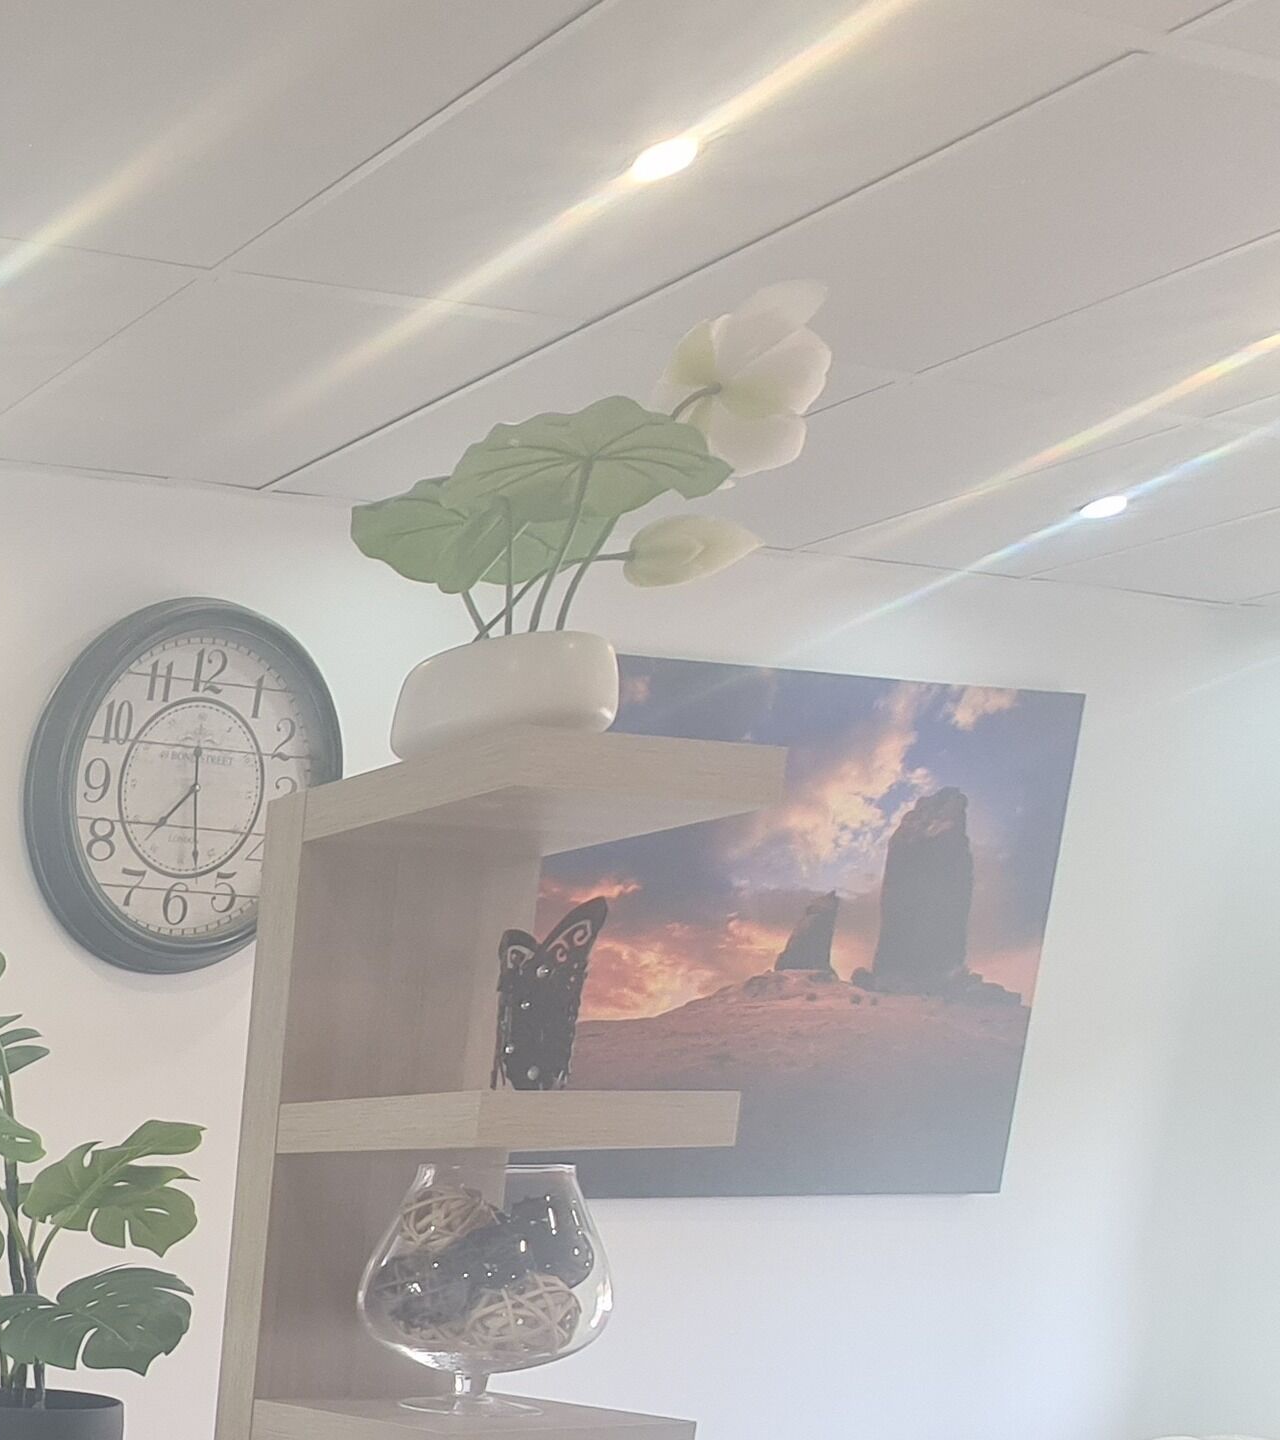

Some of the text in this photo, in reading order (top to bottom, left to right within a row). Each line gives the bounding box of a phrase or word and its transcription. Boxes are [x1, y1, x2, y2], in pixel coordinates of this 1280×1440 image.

[147, 659, 175, 702] 11
[191, 648, 228, 693] 12
[251, 675, 265, 718] 1
[102, 699, 133, 745] 10
[271, 718, 296, 761] 2
[83, 758, 111, 802] 9
[86, 818, 116, 861] 8
[121, 868, 146, 906] 7
[162, 882, 188, 925] 6
[210, 872, 238, 913] 5
